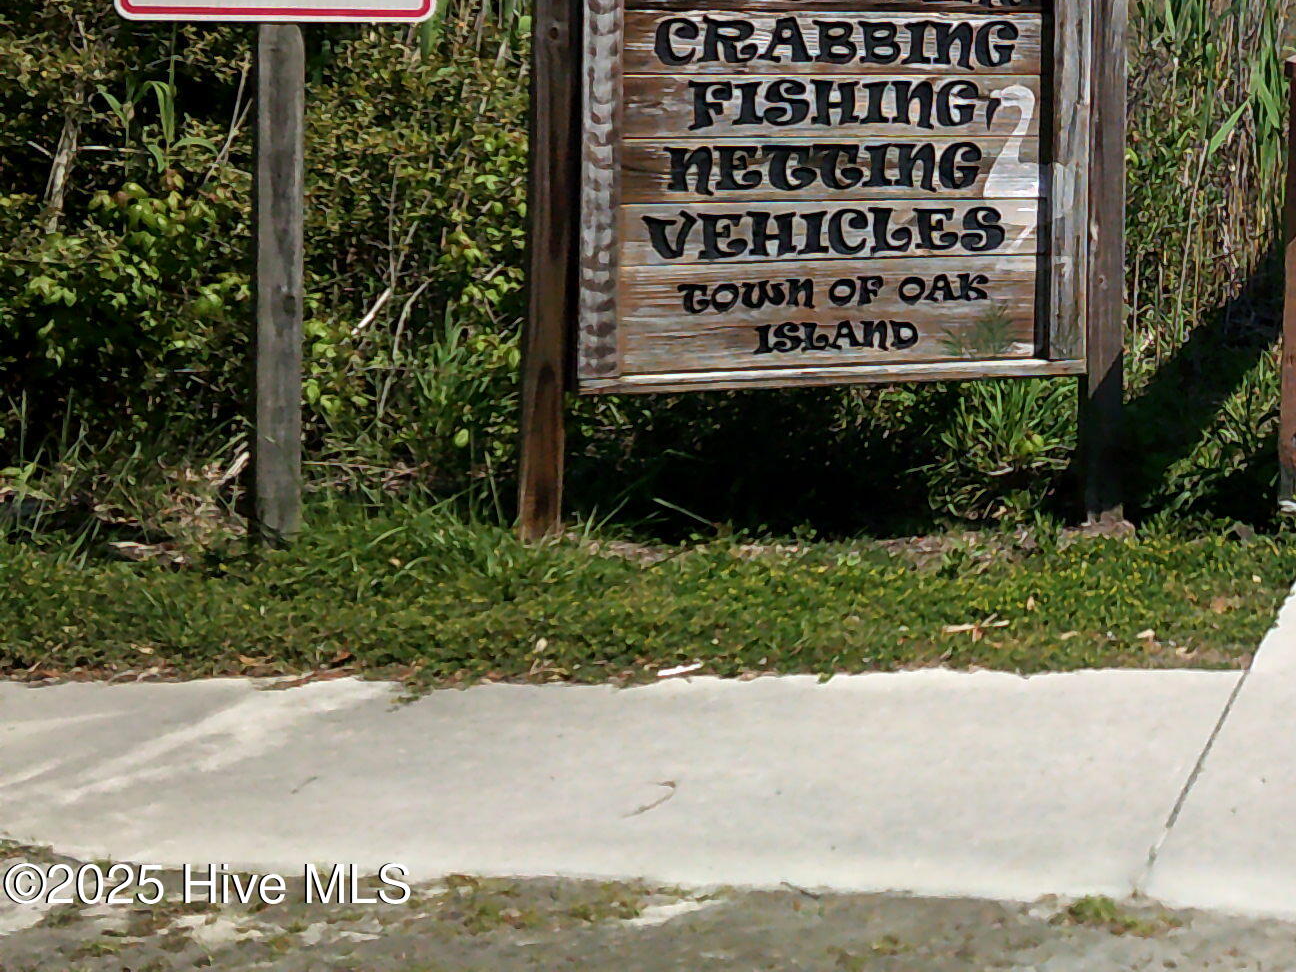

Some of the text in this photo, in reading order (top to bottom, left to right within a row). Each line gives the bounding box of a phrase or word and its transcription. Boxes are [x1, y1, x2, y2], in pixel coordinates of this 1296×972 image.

[653, 14, 1020, 71] CRABBING
[663, 141, 983, 196] NETTING
[640, 205, 1007, 260] VEHICLES
[676, 272, 990, 315] TOWN OF OAK
[752, 319, 920, 355] ISLAND
